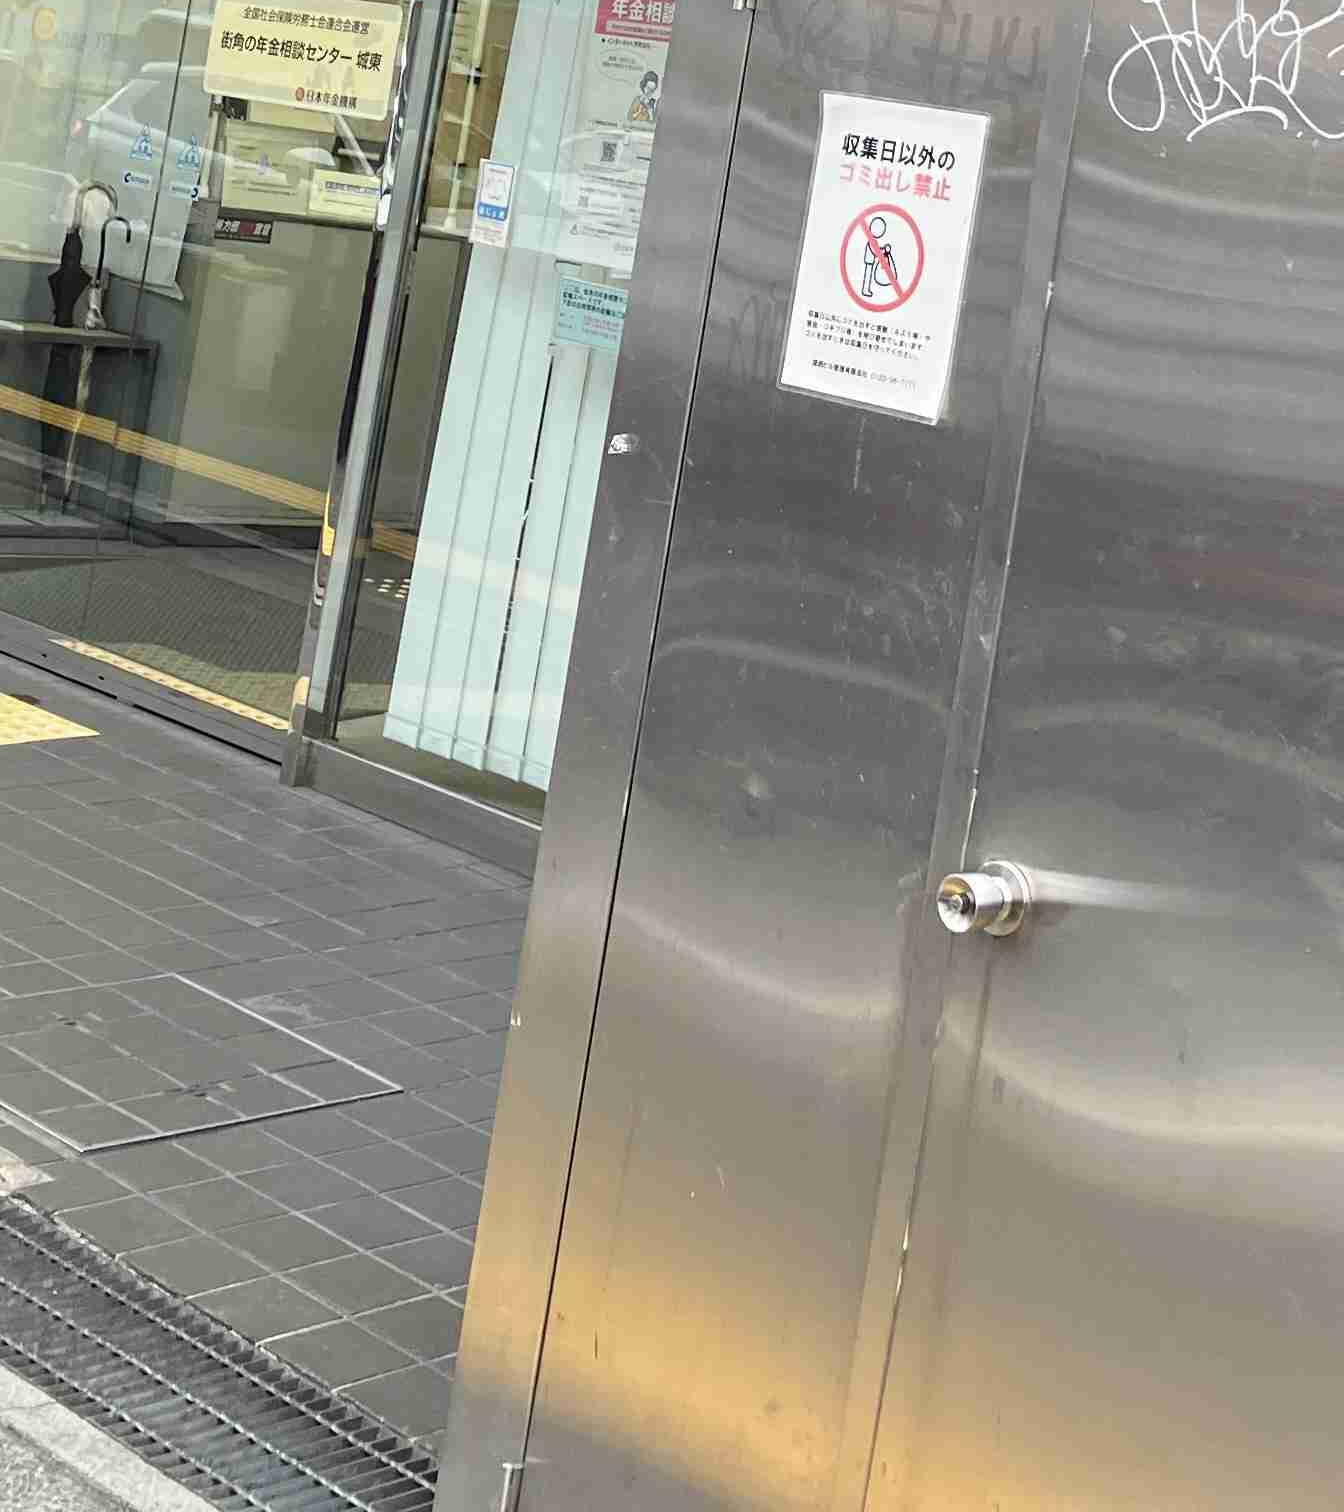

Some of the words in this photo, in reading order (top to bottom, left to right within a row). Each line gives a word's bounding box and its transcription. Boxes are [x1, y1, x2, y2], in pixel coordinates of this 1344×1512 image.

[220, 30, 353, 65] 街角の年金相談センター
[356, 50, 383, 72] 城東
[841, 132, 956, 171] 収集日以外の
[839, 163, 952, 202] ゴミ出し禁止
